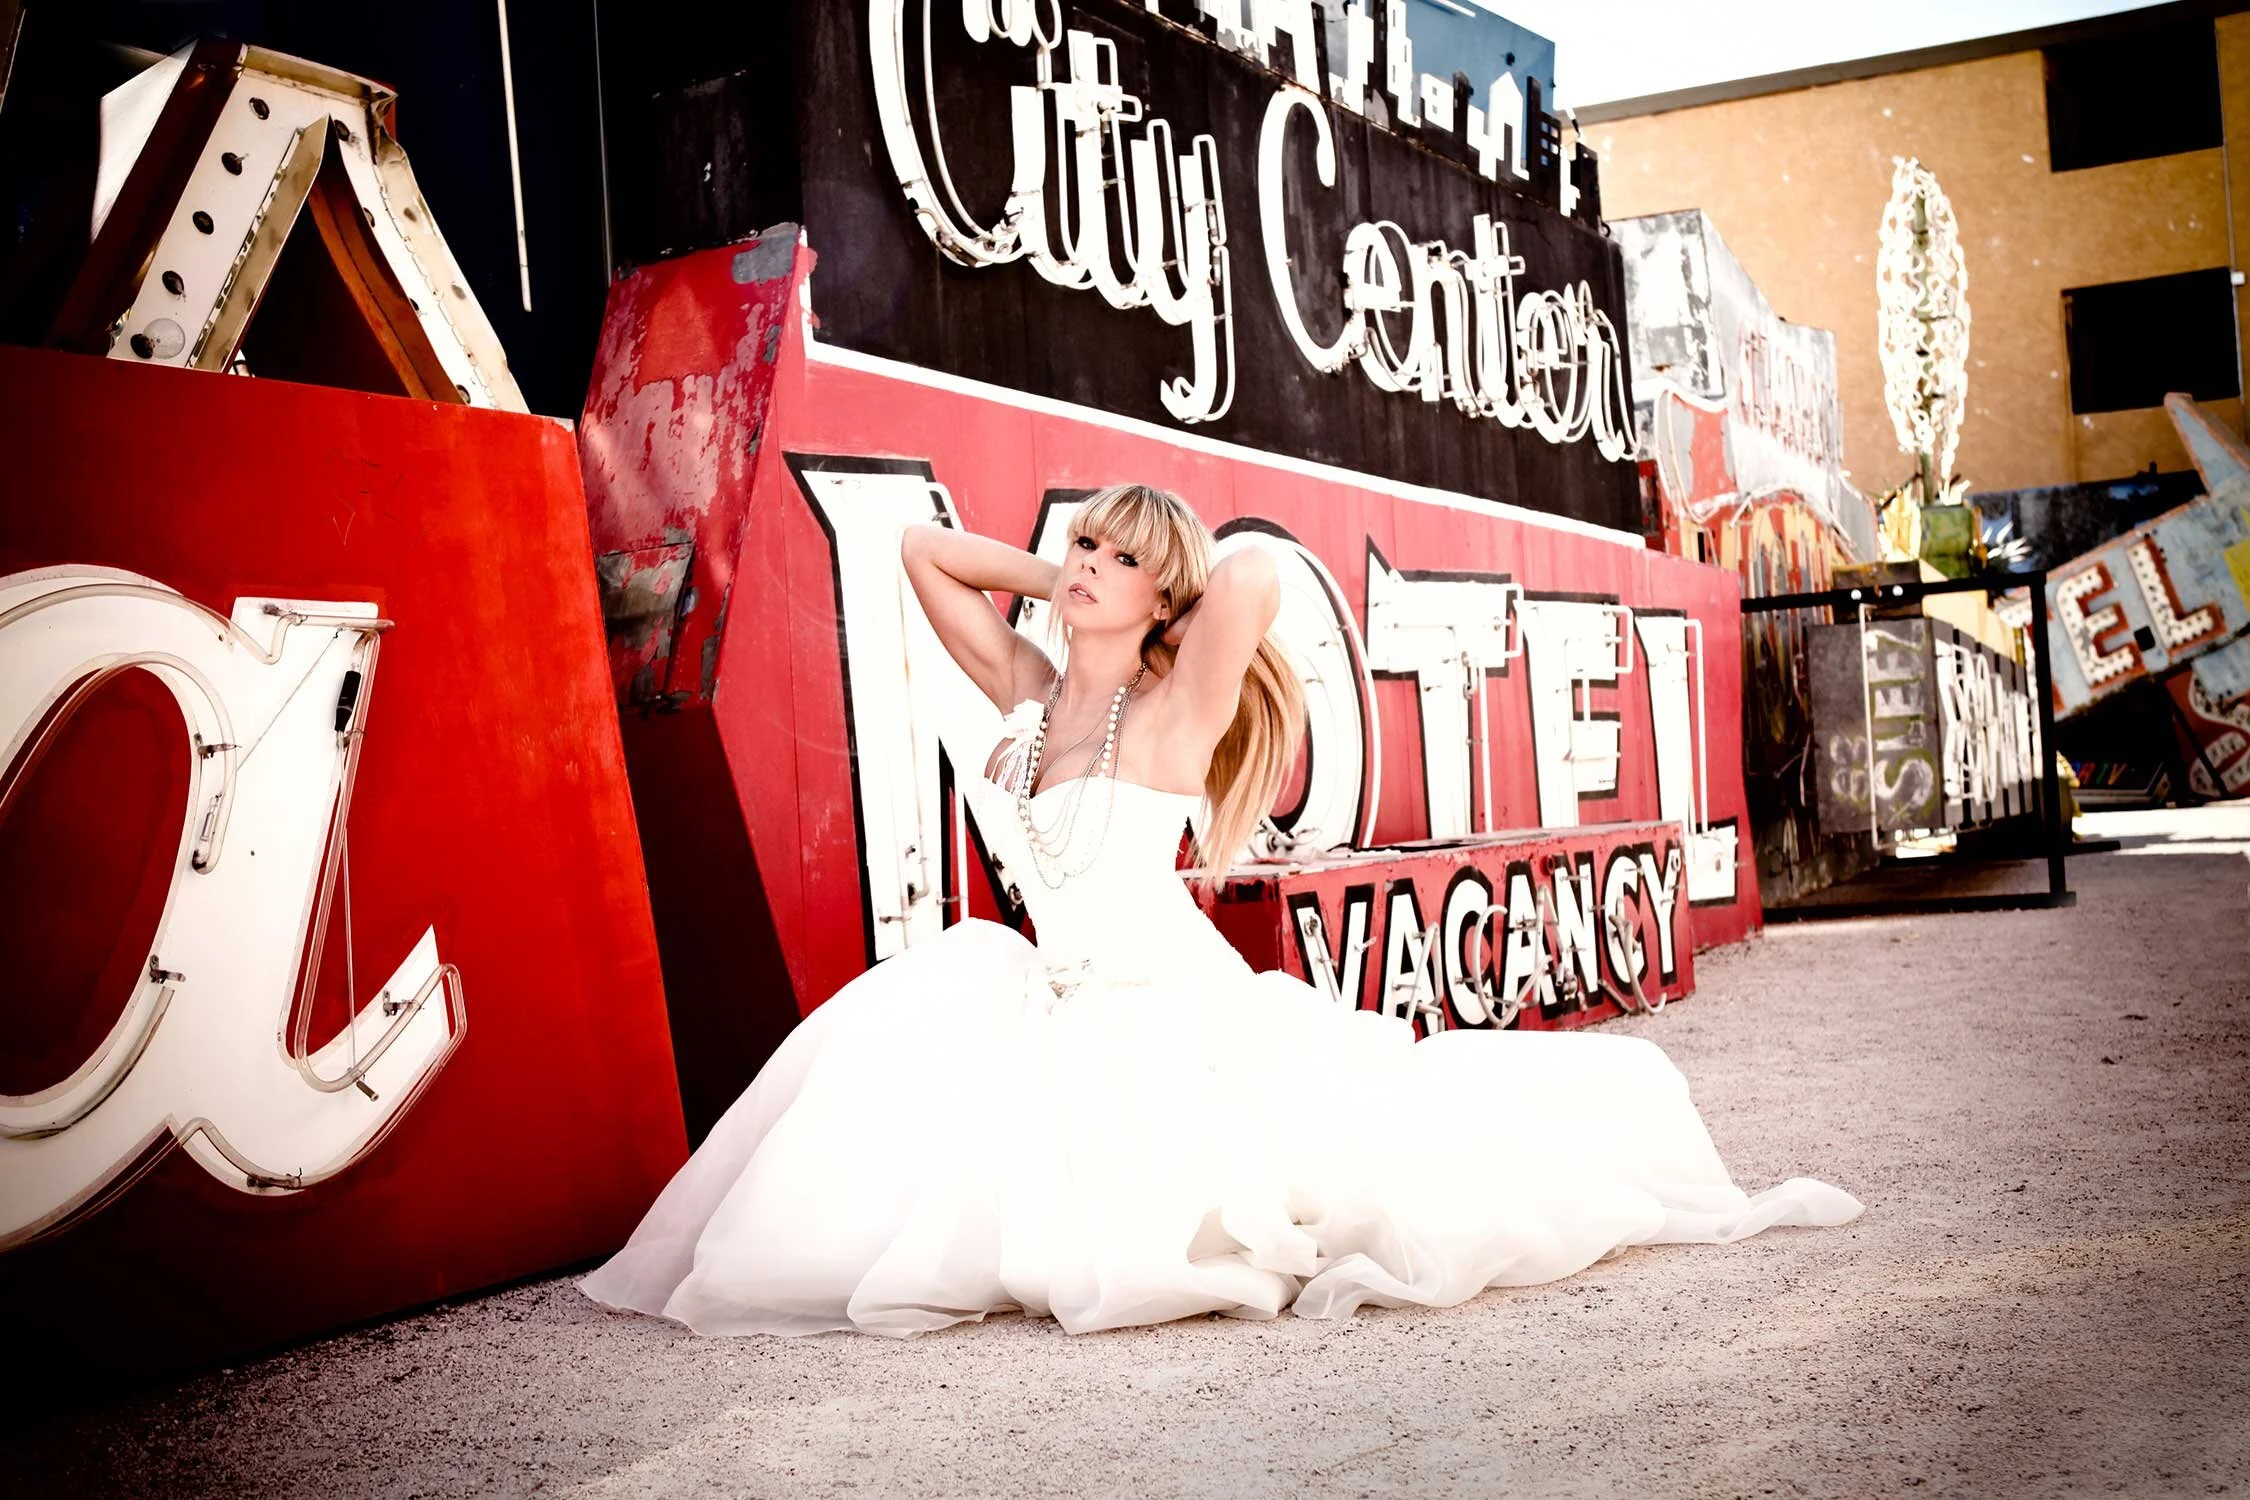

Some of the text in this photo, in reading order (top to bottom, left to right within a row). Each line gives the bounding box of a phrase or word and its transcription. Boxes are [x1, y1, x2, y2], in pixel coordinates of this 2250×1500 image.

[868, 0, 1641, 463] City Center
[1286, 838, 1682, 1036] VACANCY
